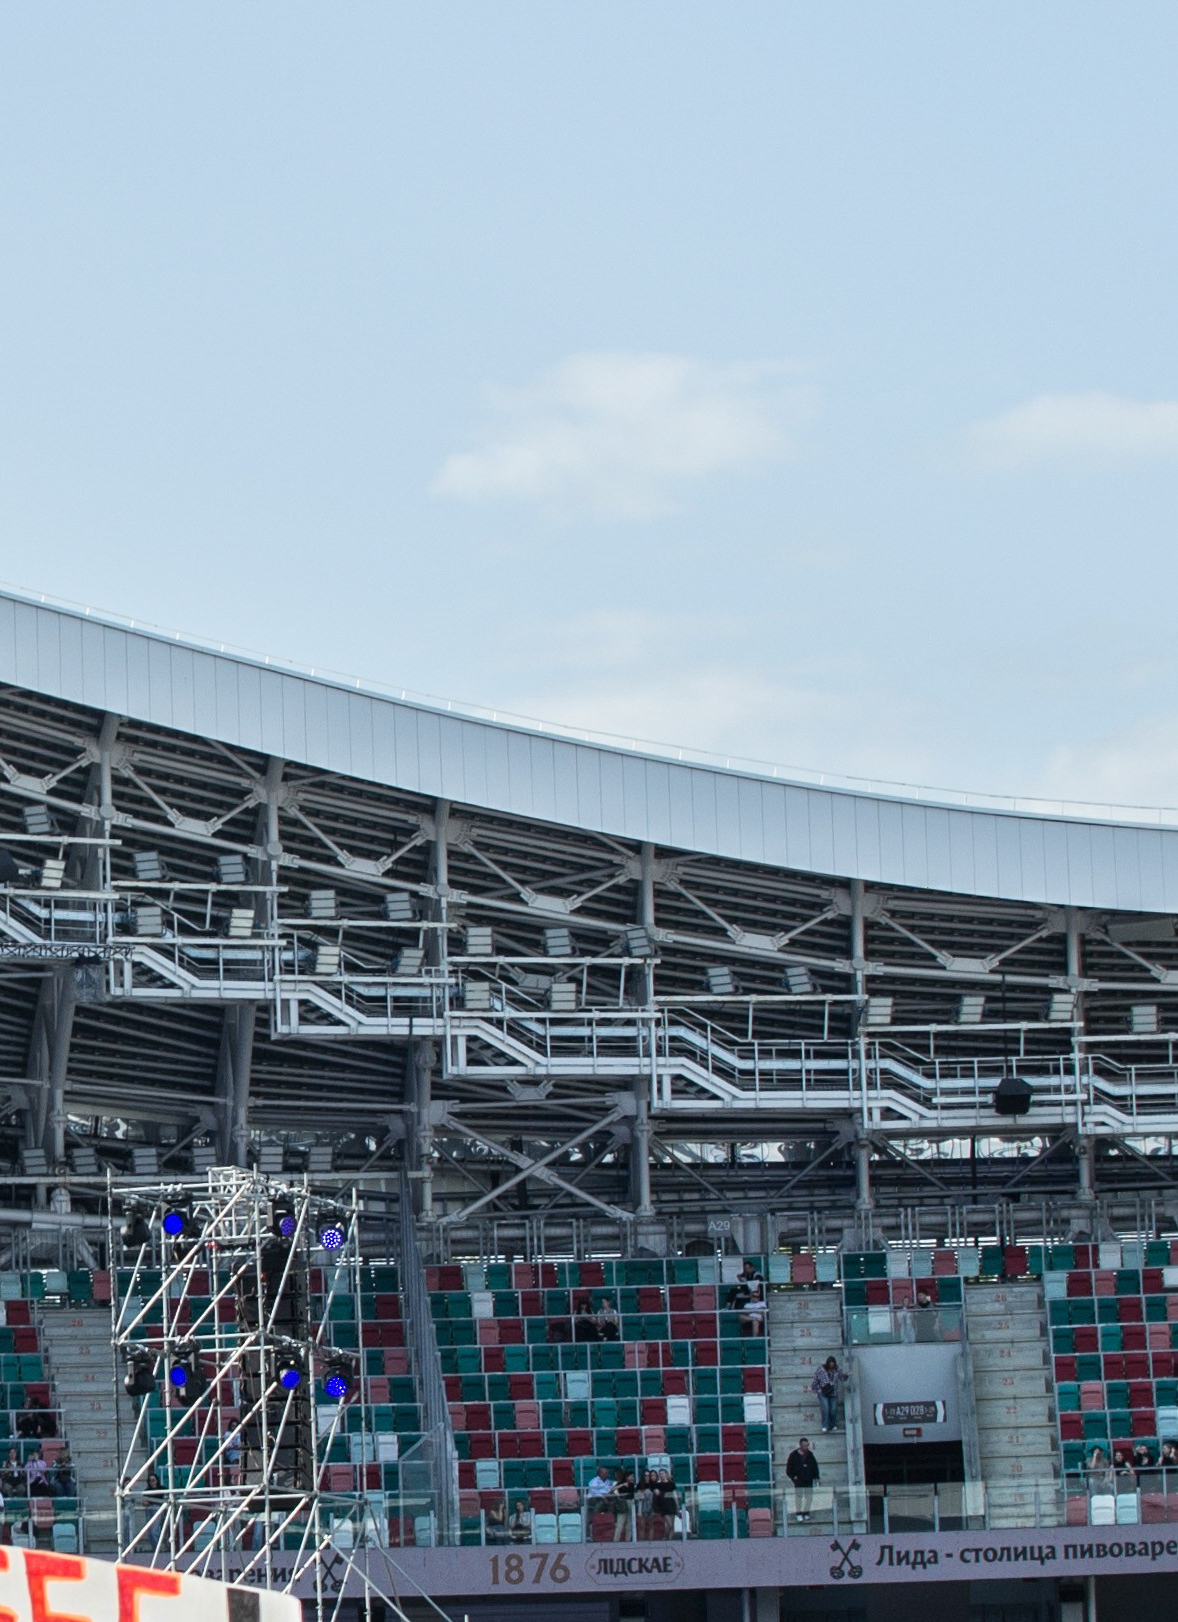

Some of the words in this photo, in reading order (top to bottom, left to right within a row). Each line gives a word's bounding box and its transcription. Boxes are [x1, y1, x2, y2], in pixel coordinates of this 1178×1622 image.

[708, 1220, 731, 1231] A29
[488, 1552, 572, 1586] 1876
[875, 1544, 939, 1570] Лида
[959, 1542, 1057, 1565] столица
[1063, 1539, 1178, 1562] пивоваре
